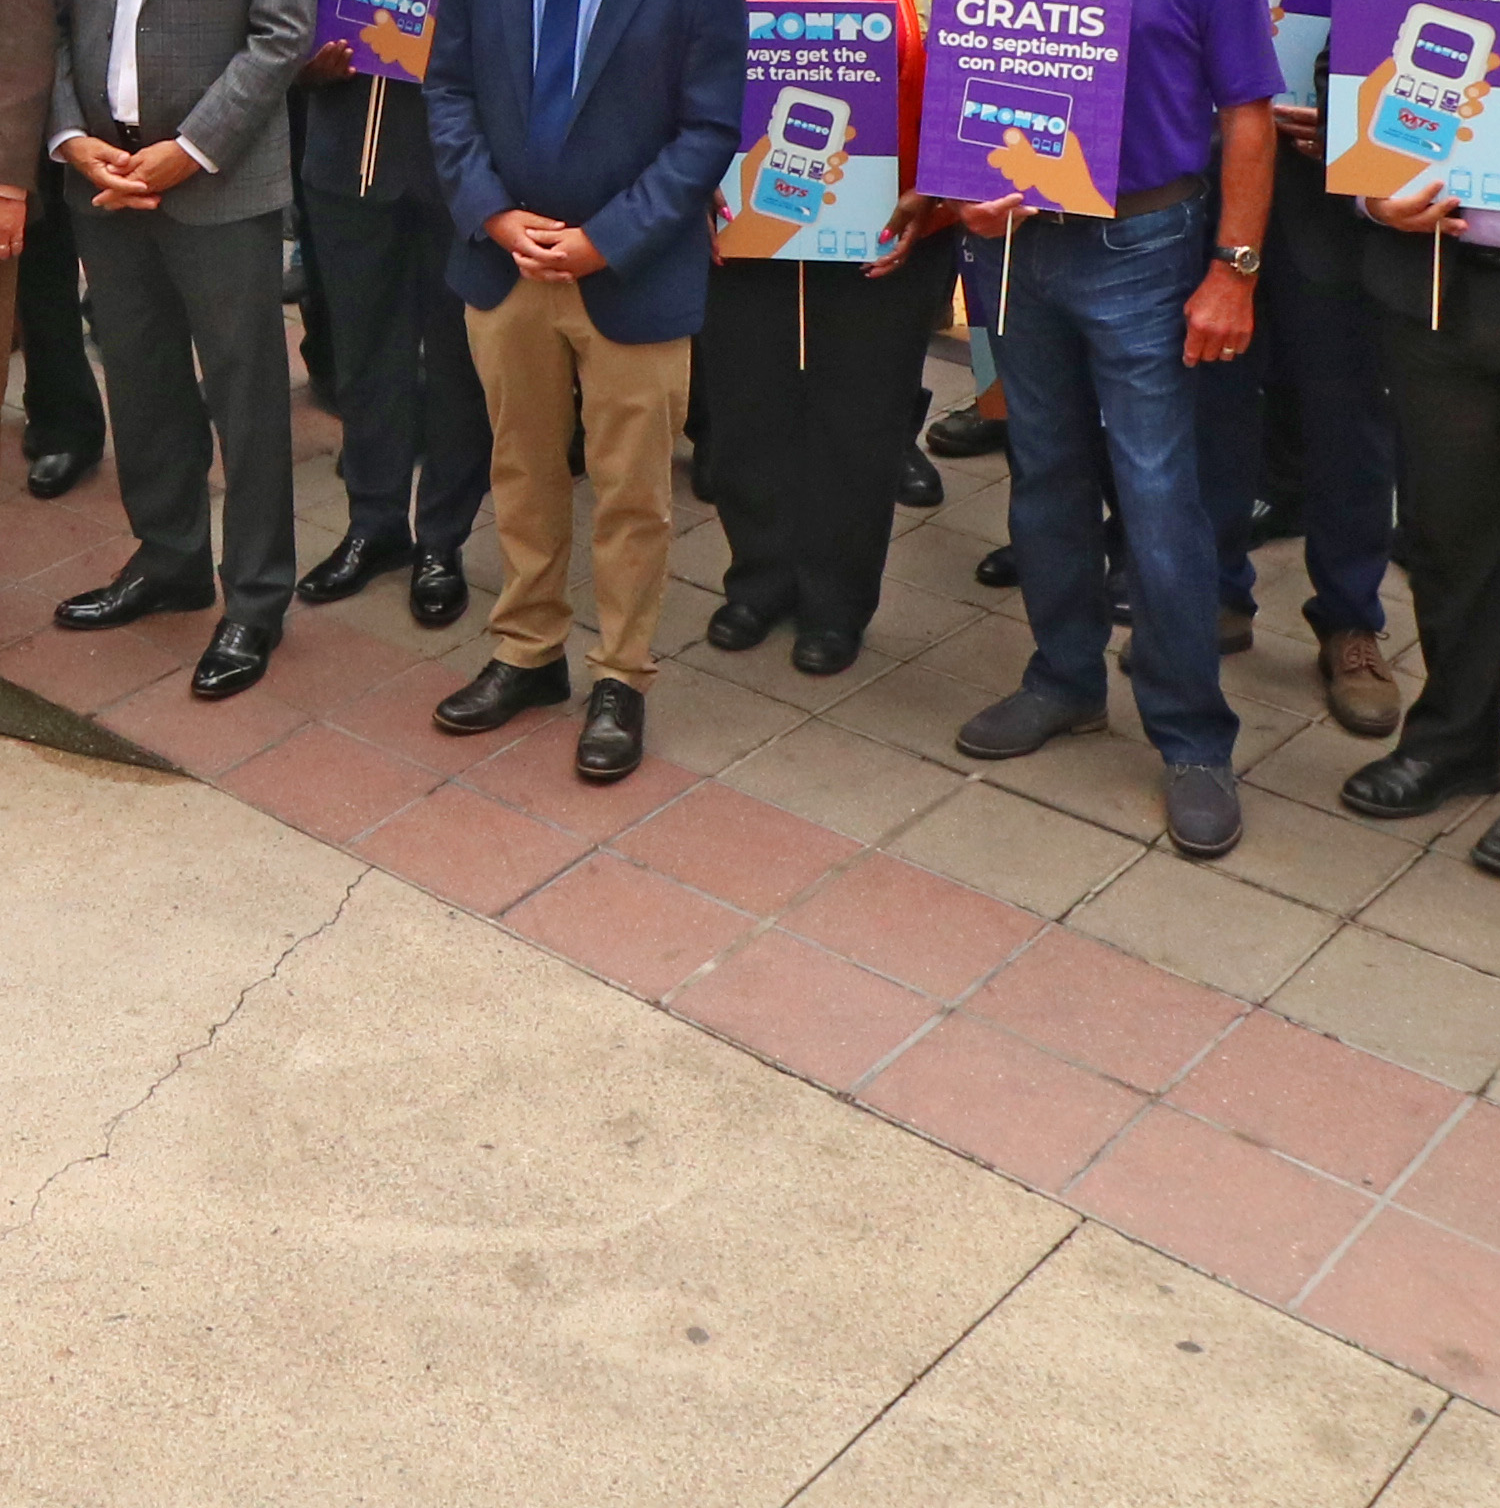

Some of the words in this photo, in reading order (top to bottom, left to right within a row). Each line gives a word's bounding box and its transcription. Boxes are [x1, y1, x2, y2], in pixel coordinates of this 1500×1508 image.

[796, 48, 829, 66] get
[833, 47, 868, 63] the
[938, 29, 988, 49] todo
[993, 34, 1119, 62] septiembre
[769, 65, 833, 82] transit
[837, 66, 881, 82] fare.
[959, 54, 995, 71] con
[1000, 57, 1094, 82] PRONTO!
[963, 100, 1066, 135] PRONTO
